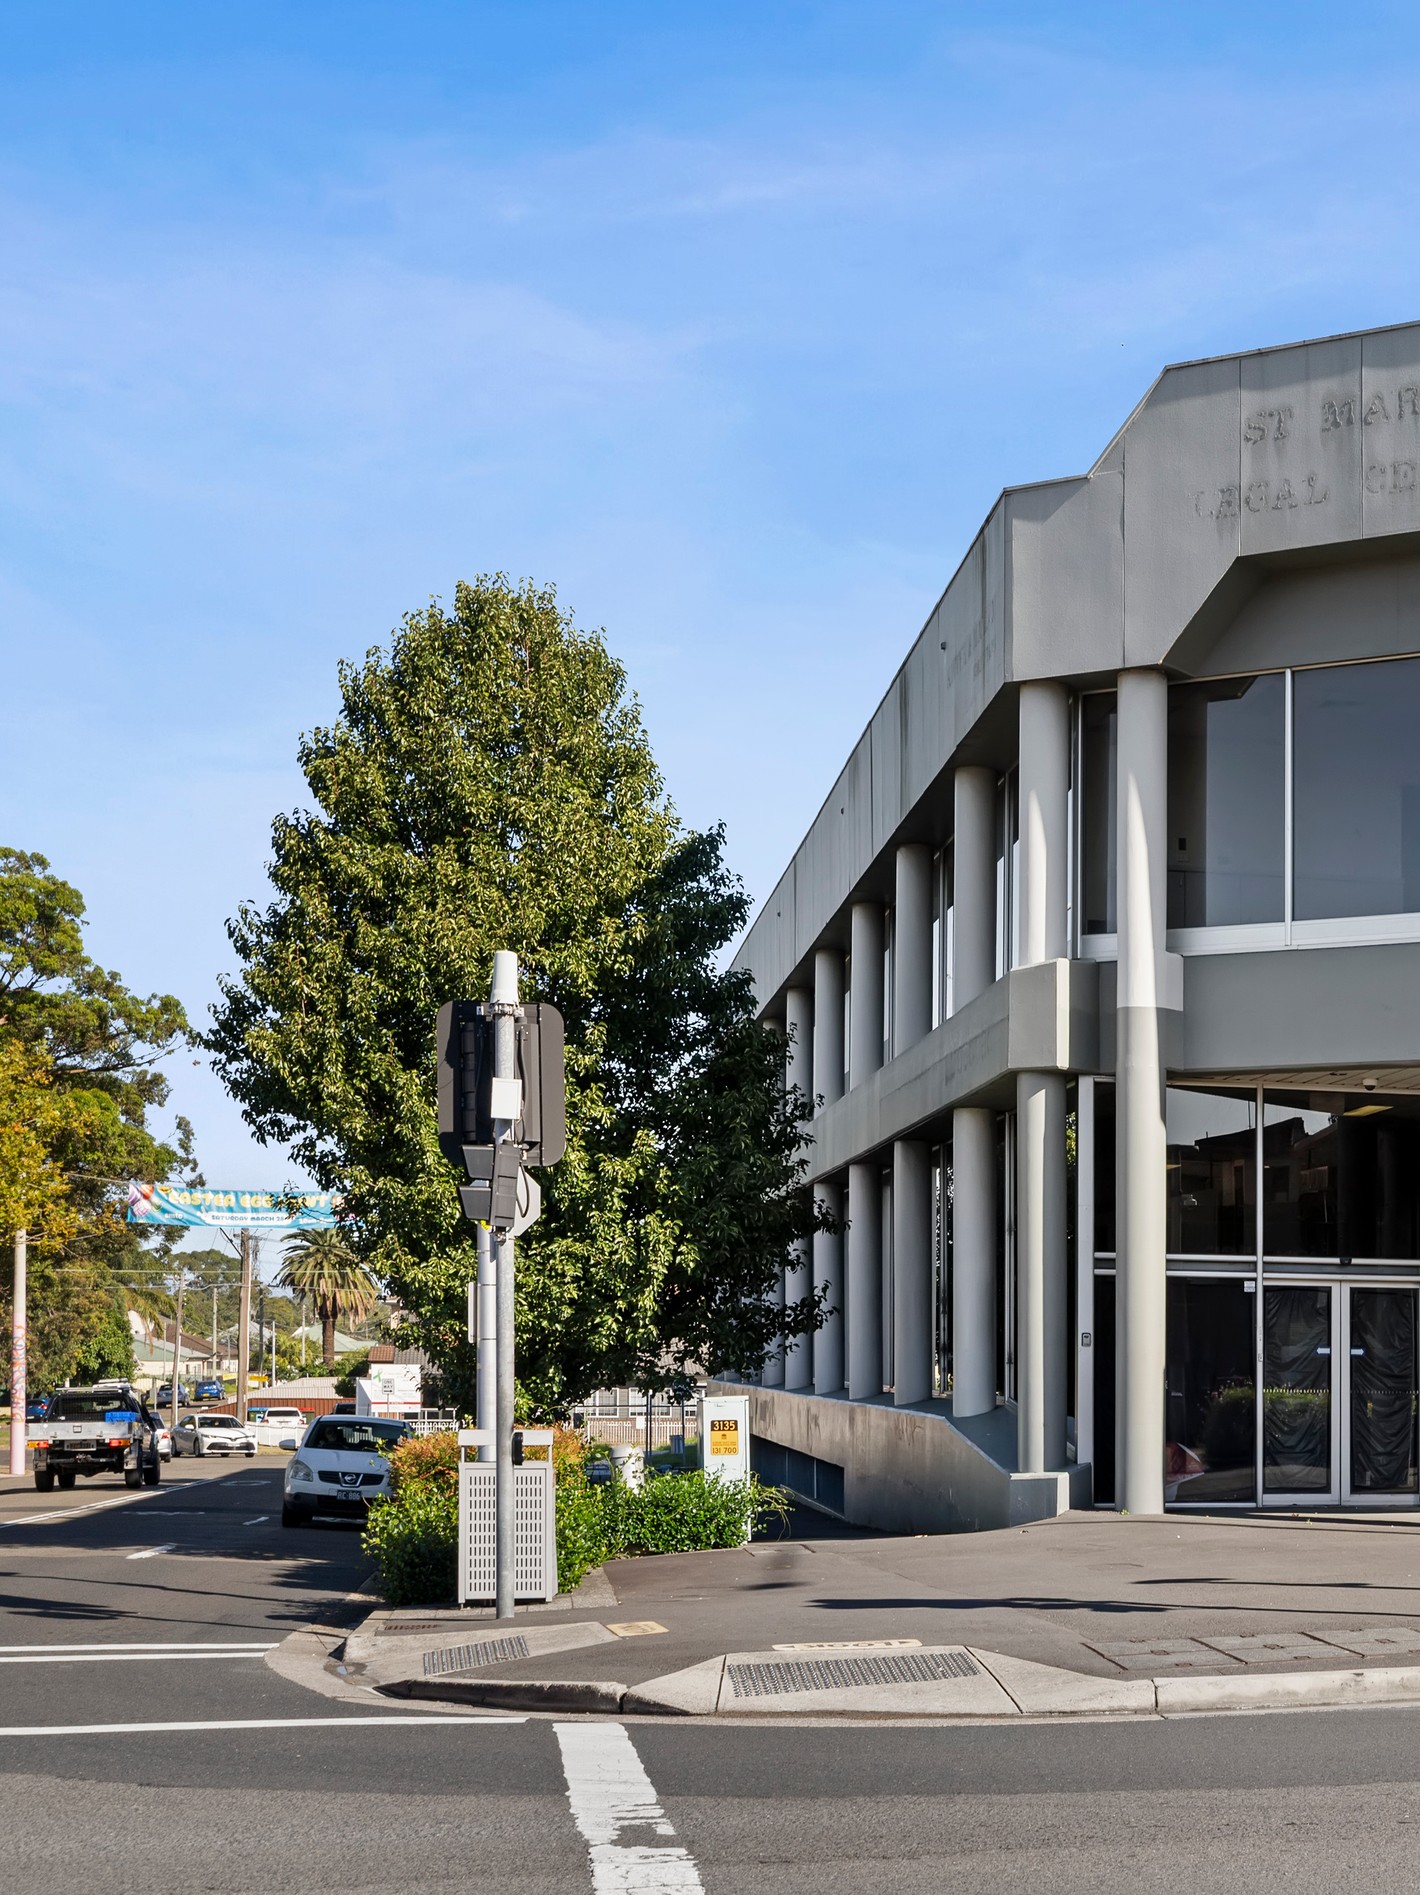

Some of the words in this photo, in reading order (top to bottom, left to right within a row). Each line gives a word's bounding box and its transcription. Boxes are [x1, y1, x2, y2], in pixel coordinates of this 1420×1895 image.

[1243, 407, 1294, 446] ST
[167, 1190, 236, 1208] EASTER
[239, 1194, 274, 1209] EGG
[211, 1214, 249, 1222] SATURDAY
[713, 1420, 736, 1431] 3135
